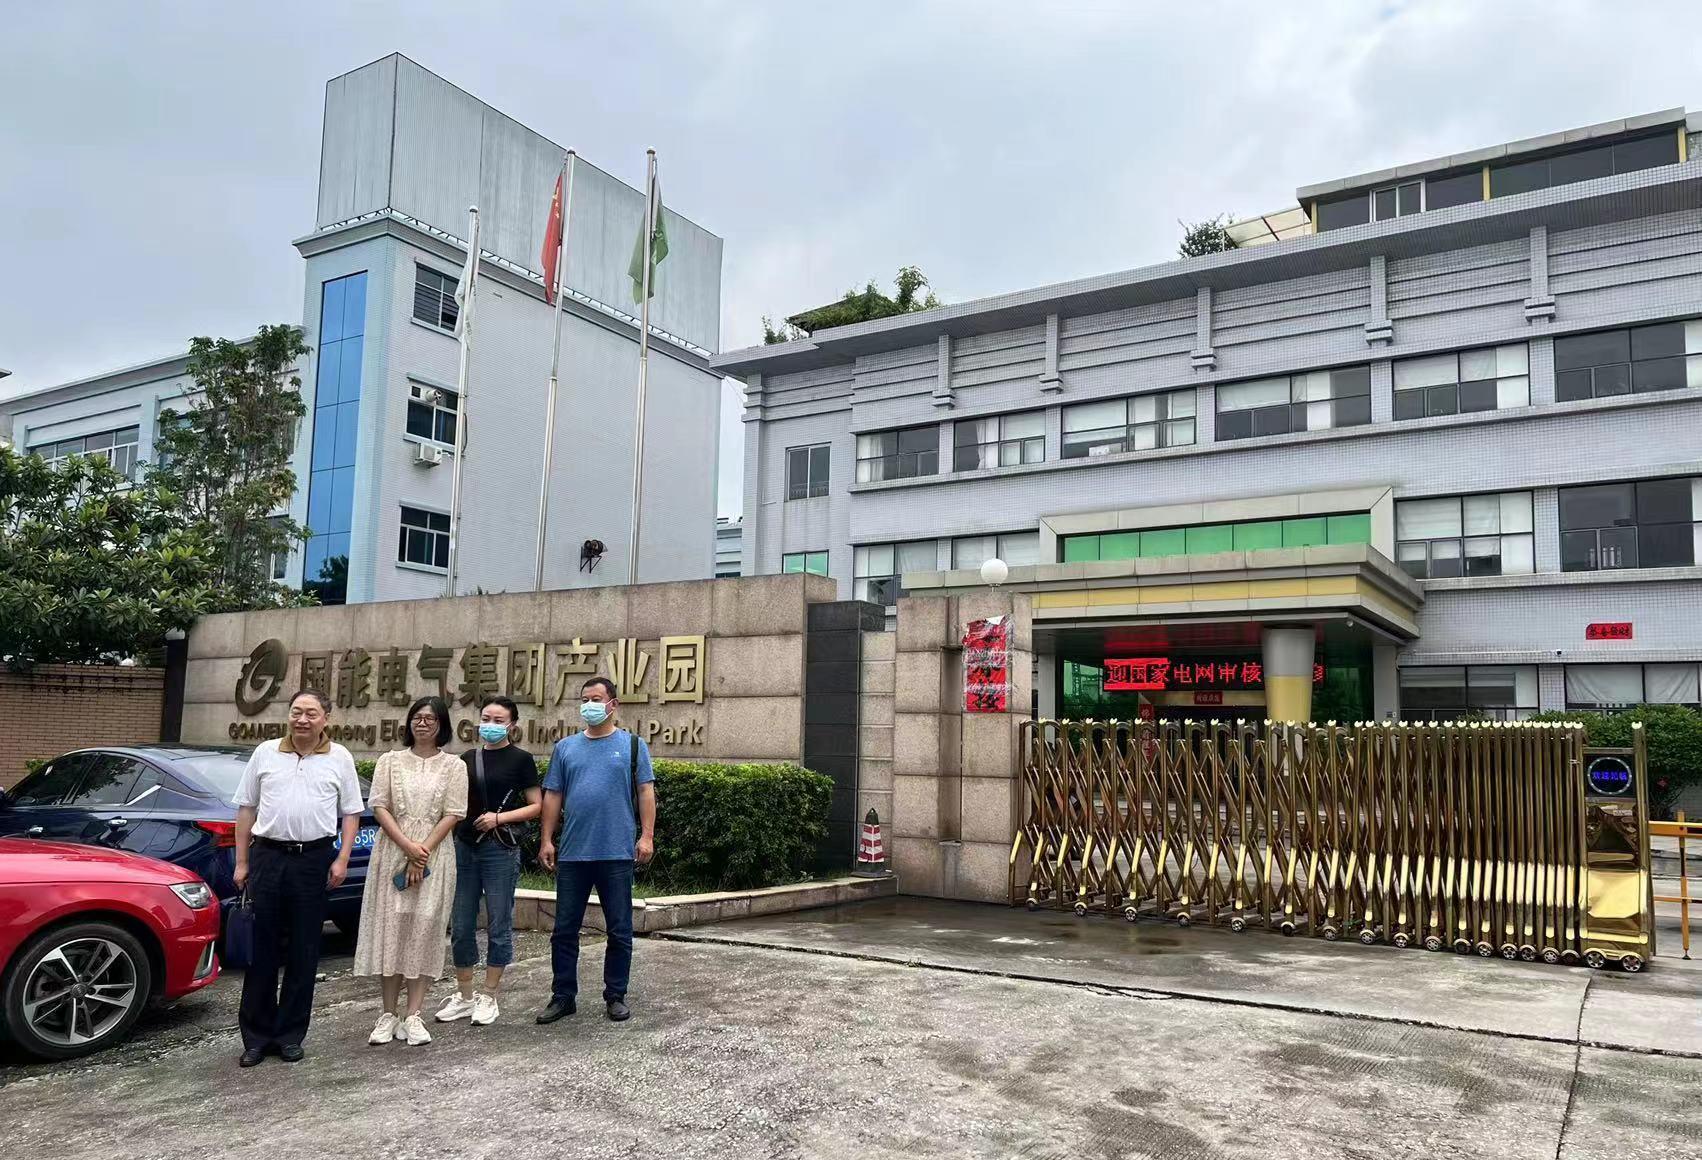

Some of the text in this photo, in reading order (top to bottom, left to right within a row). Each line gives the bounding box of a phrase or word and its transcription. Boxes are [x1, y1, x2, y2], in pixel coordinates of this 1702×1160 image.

[300, 635, 707, 709] 国能电气集团产业园
[1106, 662, 1324, 684] 迎国家电网审核
[648, 718, 705, 745] Park
